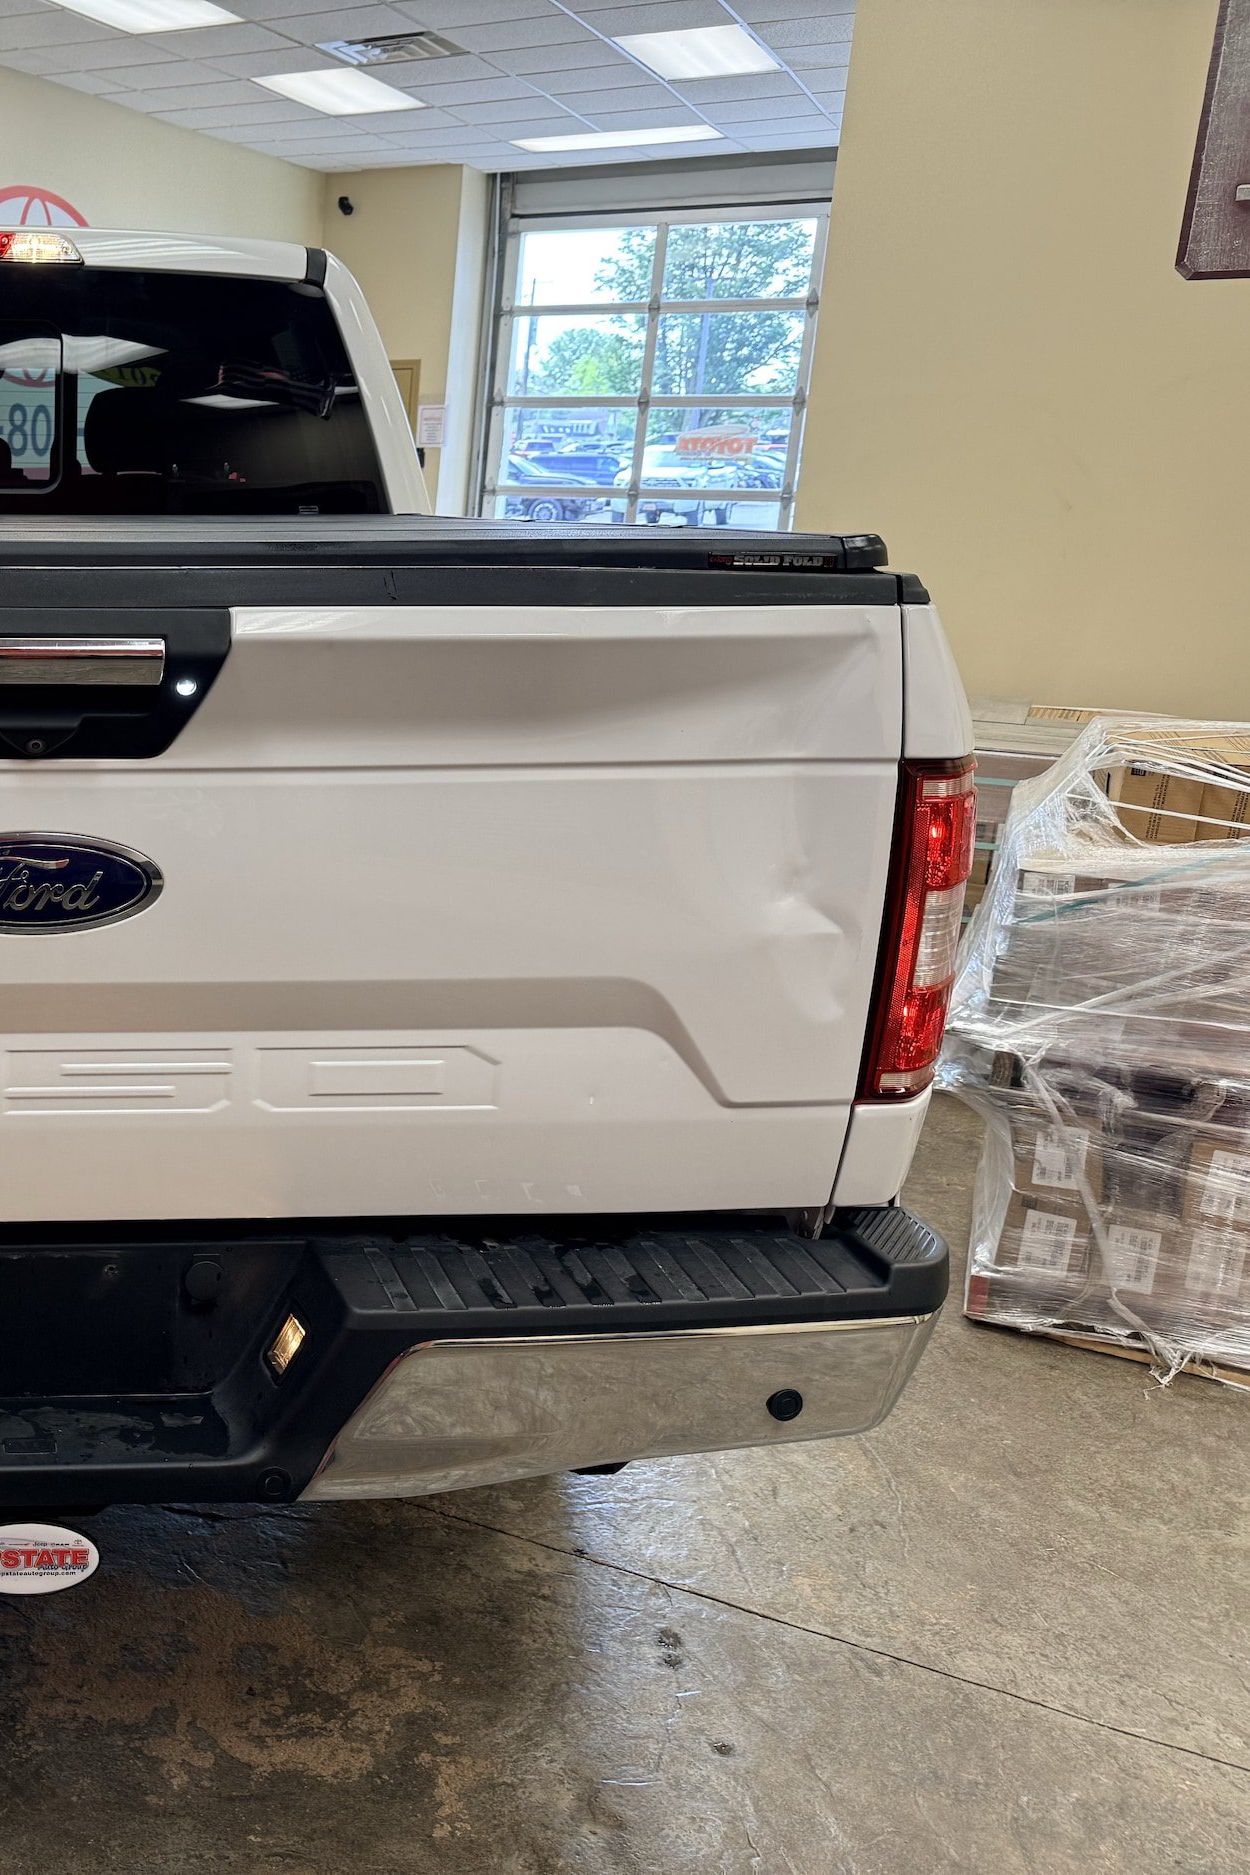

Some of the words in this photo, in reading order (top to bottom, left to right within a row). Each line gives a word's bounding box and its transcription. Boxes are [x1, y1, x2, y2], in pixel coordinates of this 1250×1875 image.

[733, 556, 781, 566] SOLID
[782, 556, 823, 566] FOLD
[38, 1563, 59, 1571] Auto
[60, 1562, 89, 1572] Group
